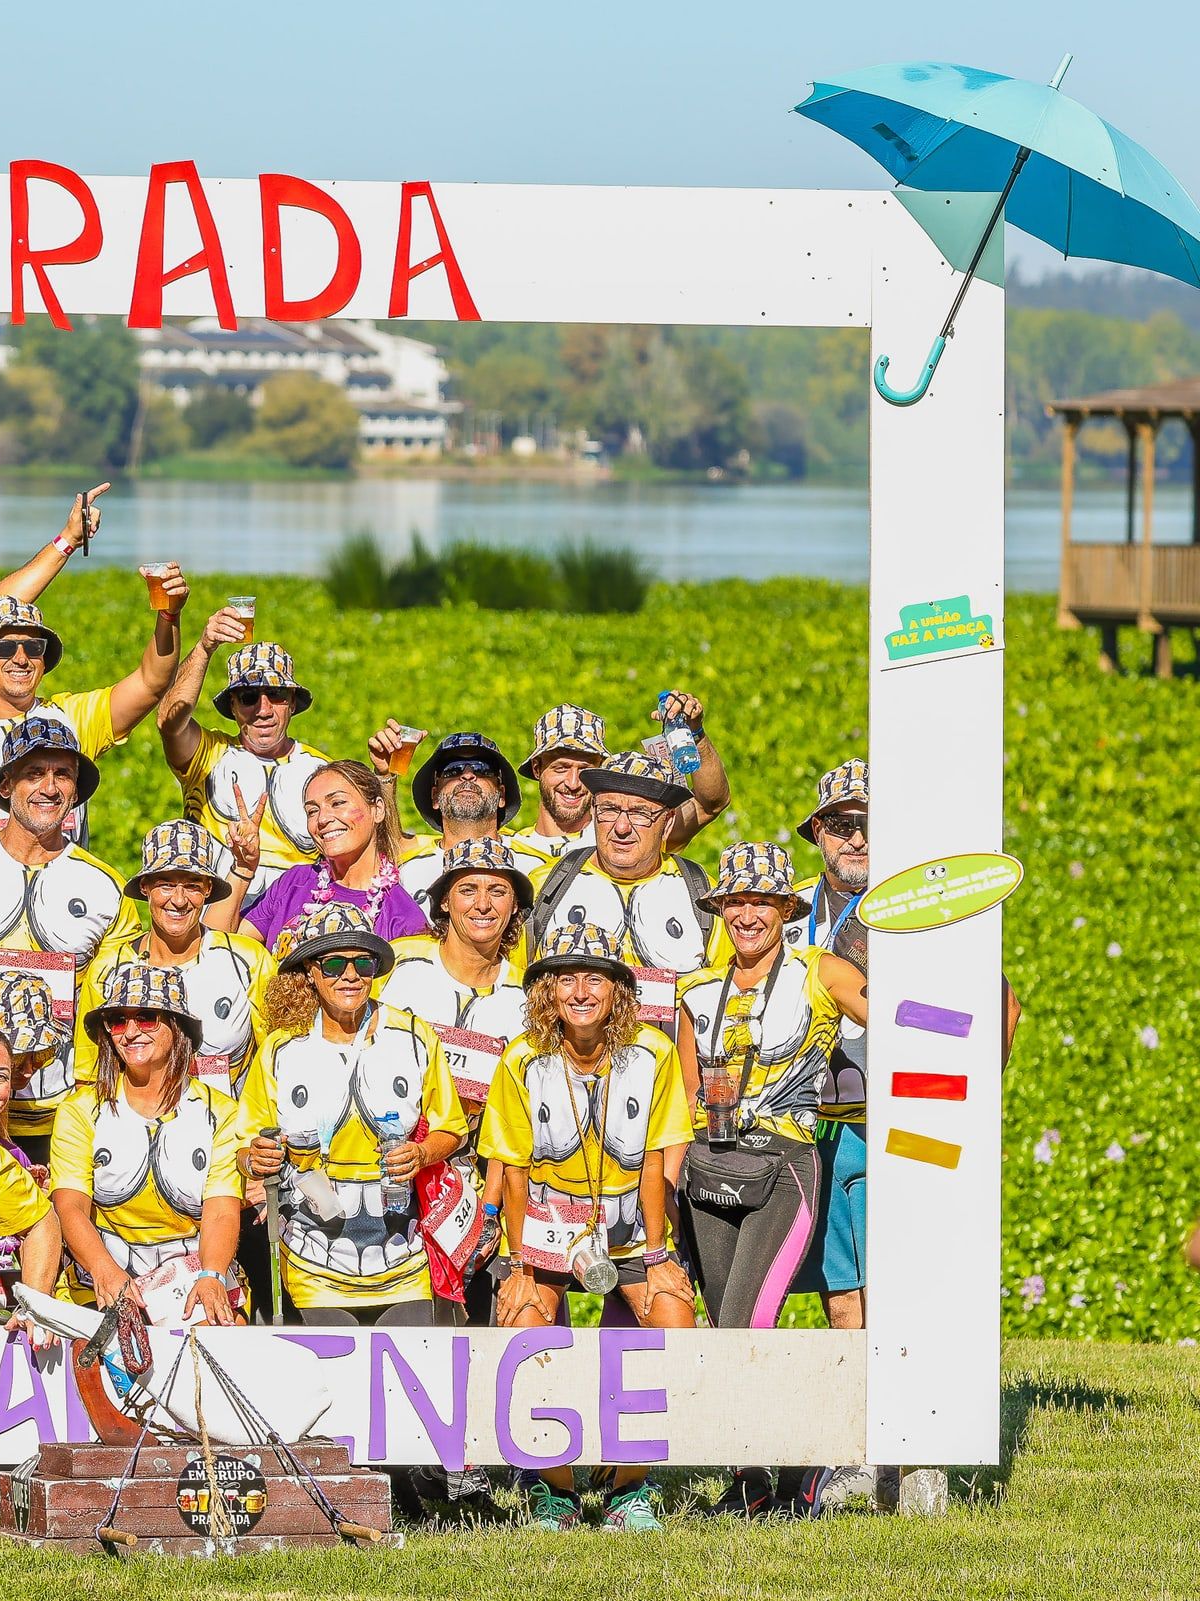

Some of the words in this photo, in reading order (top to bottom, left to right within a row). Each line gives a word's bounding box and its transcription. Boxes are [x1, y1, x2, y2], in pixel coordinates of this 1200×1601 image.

[909, 619, 919, 630] A
[920, 611, 961, 627] UNIÃO
[891, 631, 920, 648] FAZ
[922, 630, 935, 642] A
[936, 620, 986, 639] FORÇA
[444, 1050, 467, 1068] 371
[455, 1198, 471, 1228] 344
[194, 1461, 246, 1470] TAPIA
[188, 1470, 206, 1481] EM
